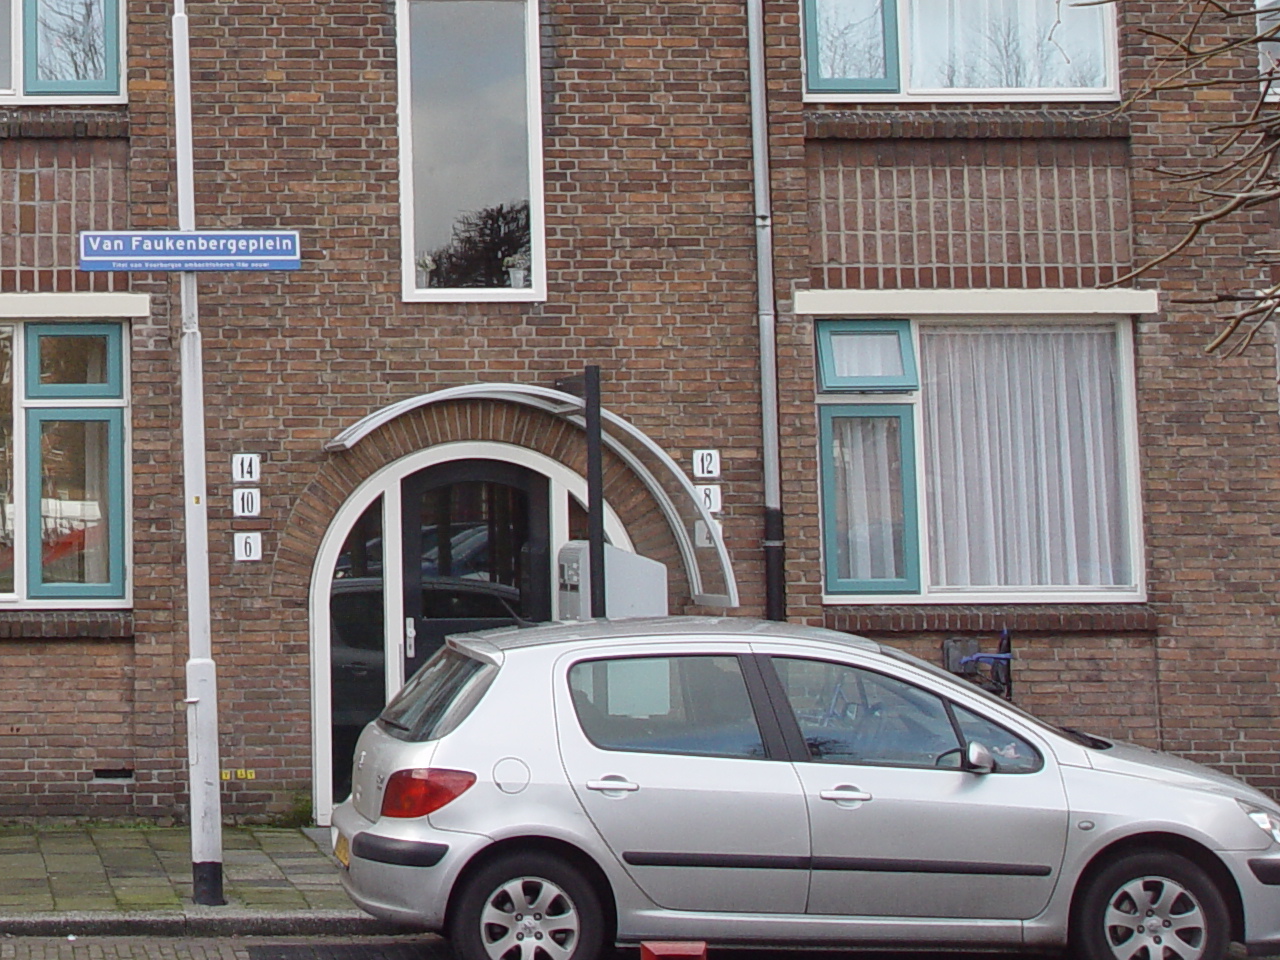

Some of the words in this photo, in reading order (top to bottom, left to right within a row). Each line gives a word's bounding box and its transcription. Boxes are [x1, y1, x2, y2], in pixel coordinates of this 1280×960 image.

[88, 236, 124, 251] Van
[131, 236, 292, 254] Faukenbergeplein
[240, 456, 253, 479] 14
[700, 452, 713, 475] 12
[241, 491, 254, 514] 10
[703, 487, 712, 510] 8
[244, 535, 252, 558] 6
